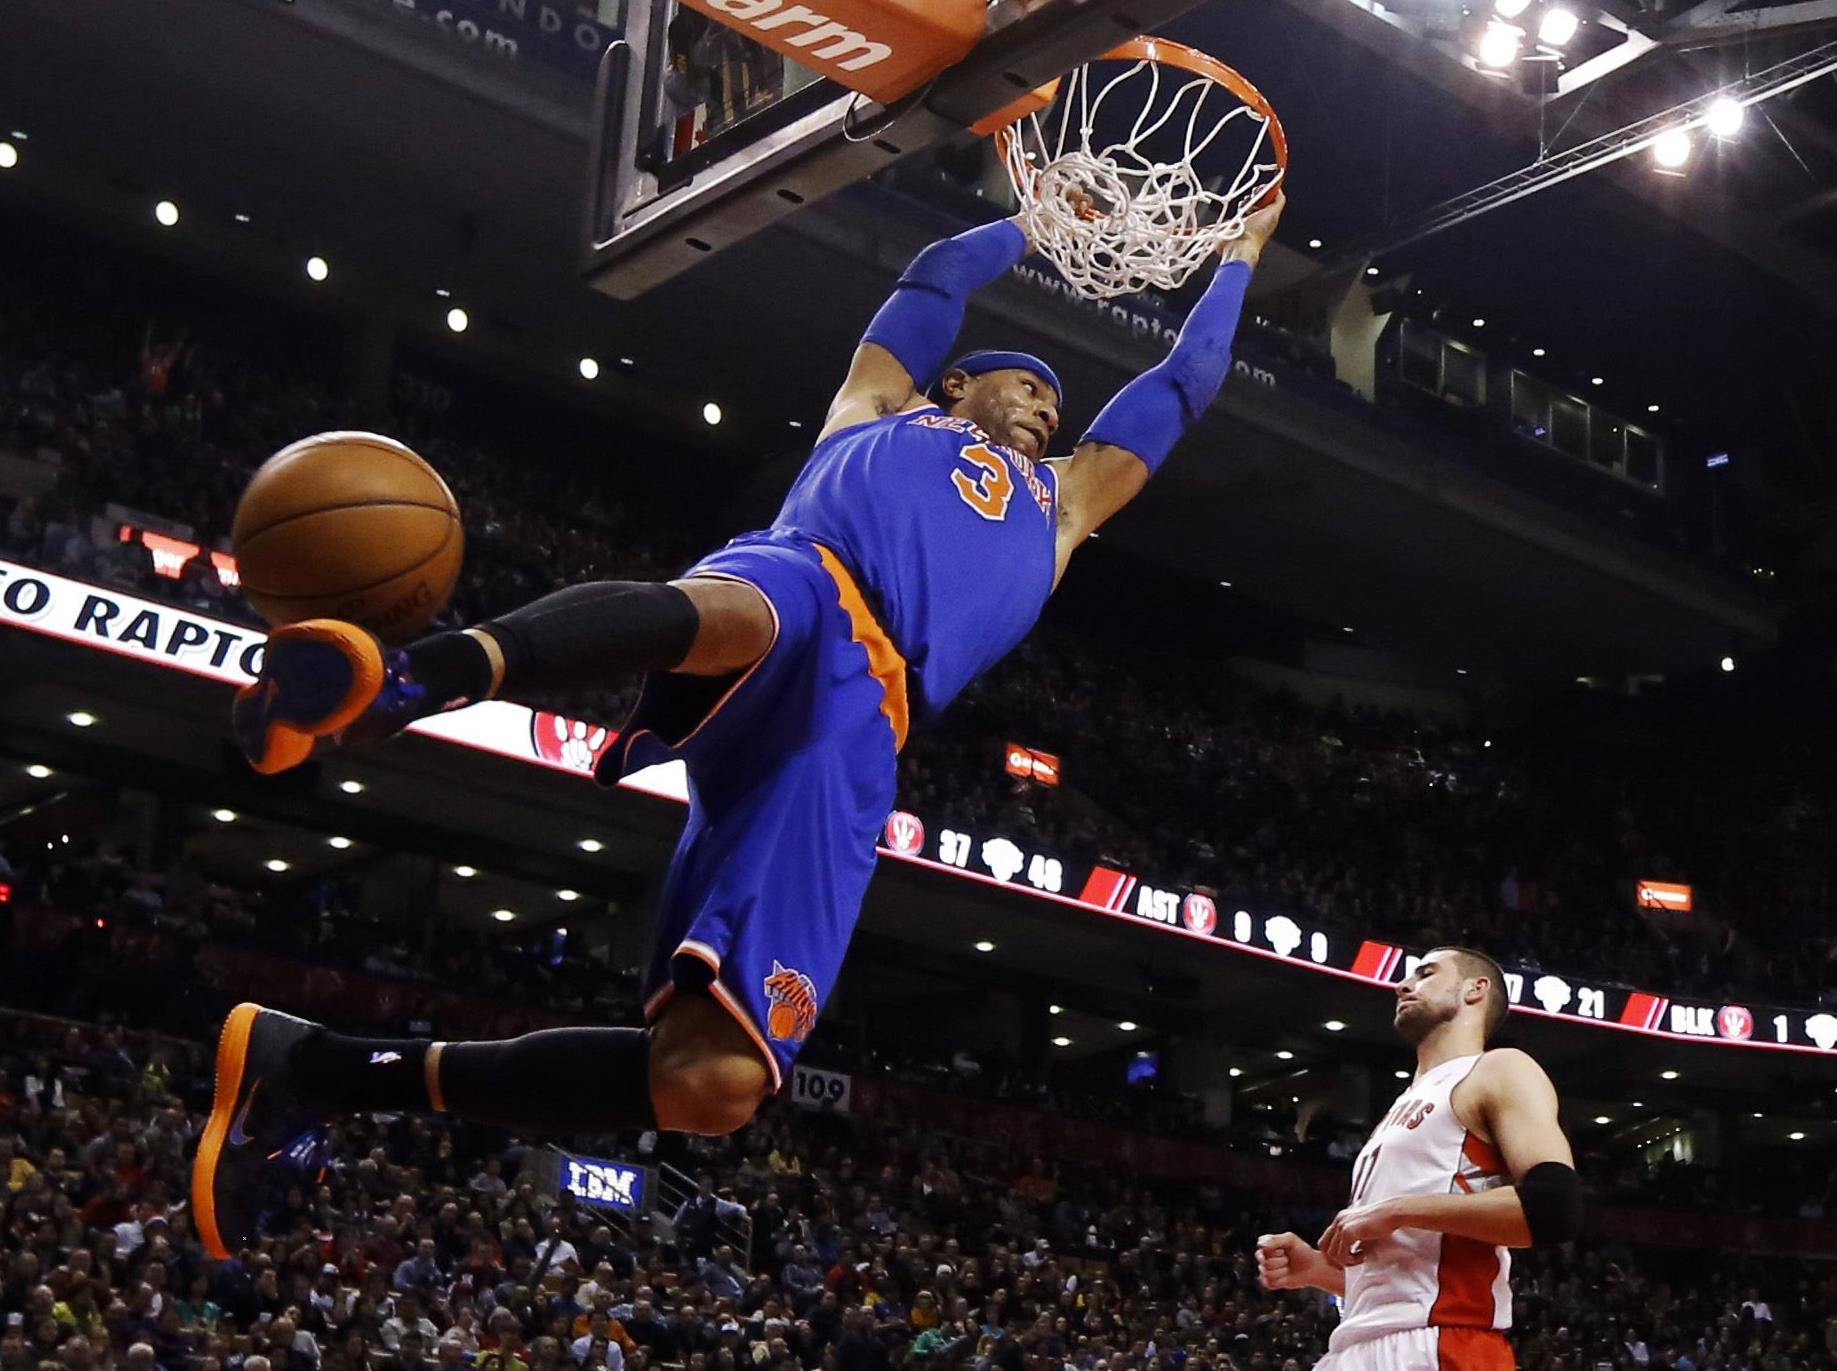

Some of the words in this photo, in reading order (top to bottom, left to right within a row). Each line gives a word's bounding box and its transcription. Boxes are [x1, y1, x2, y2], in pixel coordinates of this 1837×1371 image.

[951, 443, 1014, 520] 3
[939, 829, 972, 868] 37
[1137, 885, 1180, 924] AST
[1577, 986, 1605, 1019] 21
[1670, 1005, 1714, 1036] BLK
[1773, 1014, 1788, 1043] 1
[796, 1073, 845, 1103] 109
[567, 1161, 636, 1204] IBM
